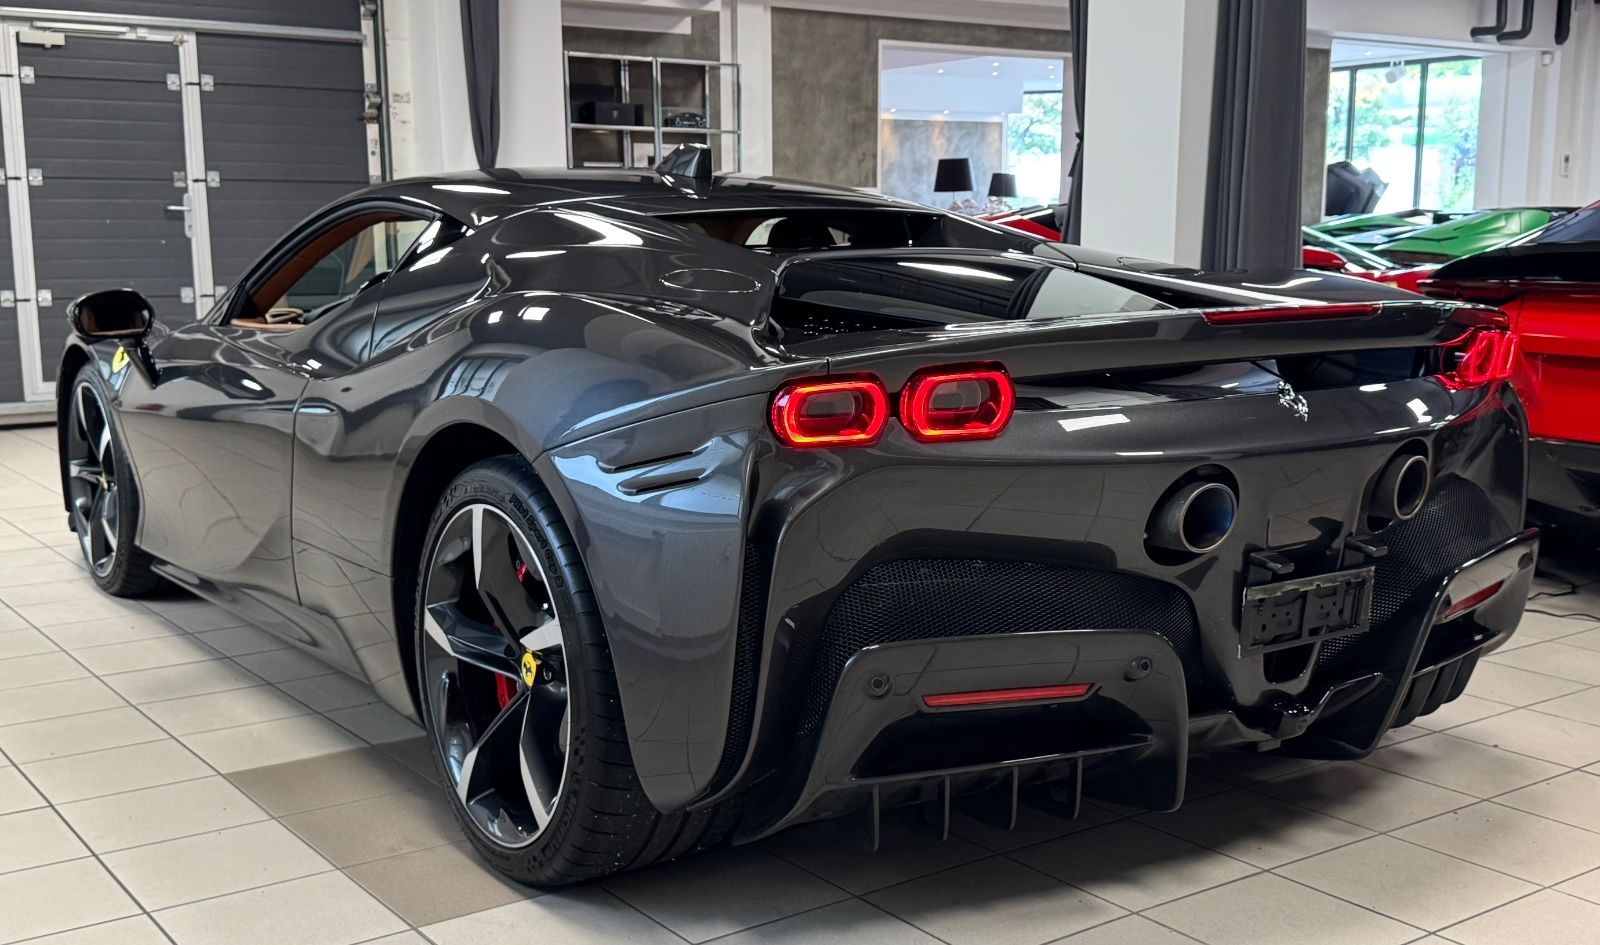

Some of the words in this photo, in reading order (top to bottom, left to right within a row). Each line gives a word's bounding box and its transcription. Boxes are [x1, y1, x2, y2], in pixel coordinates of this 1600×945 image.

[509, 493, 529, 519] Pilot
[526, 514, 548, 550] Sport
[544, 548, 558, 575] Cup
